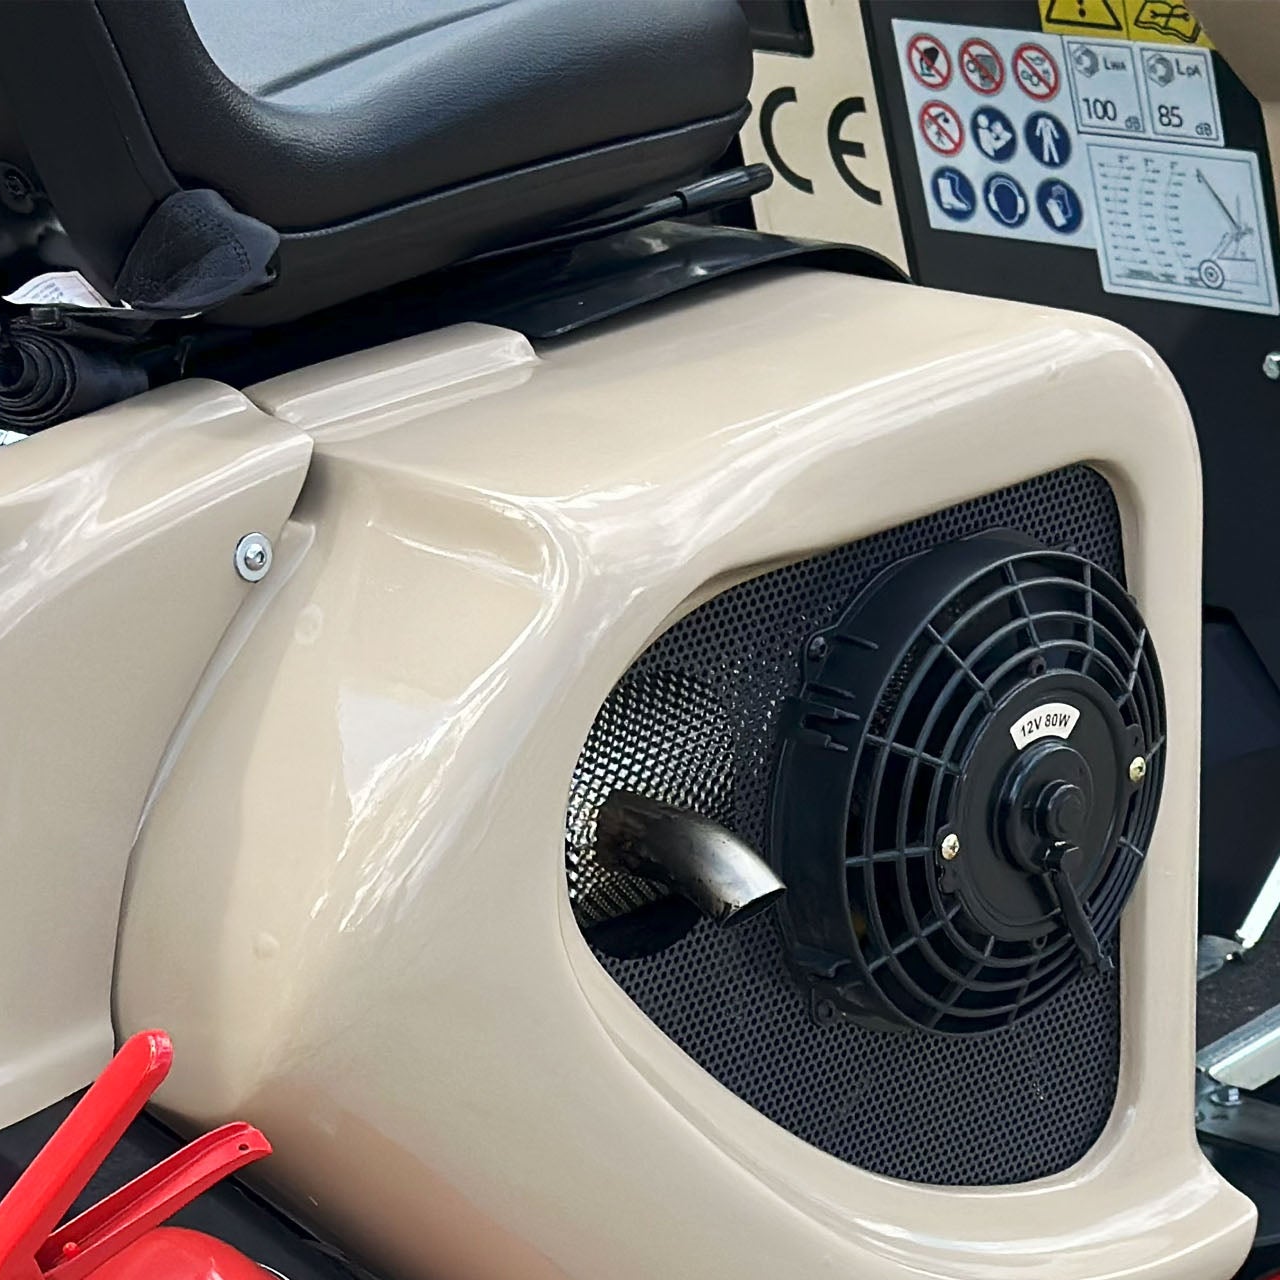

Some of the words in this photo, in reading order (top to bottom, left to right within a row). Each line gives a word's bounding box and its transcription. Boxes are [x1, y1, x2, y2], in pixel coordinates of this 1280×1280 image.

[1082, 98, 1117, 121] 100
[1158, 104, 1183, 128] 85
[1021, 716, 1042, 737] 12V
[1044, 713, 1071, 728] 80W
